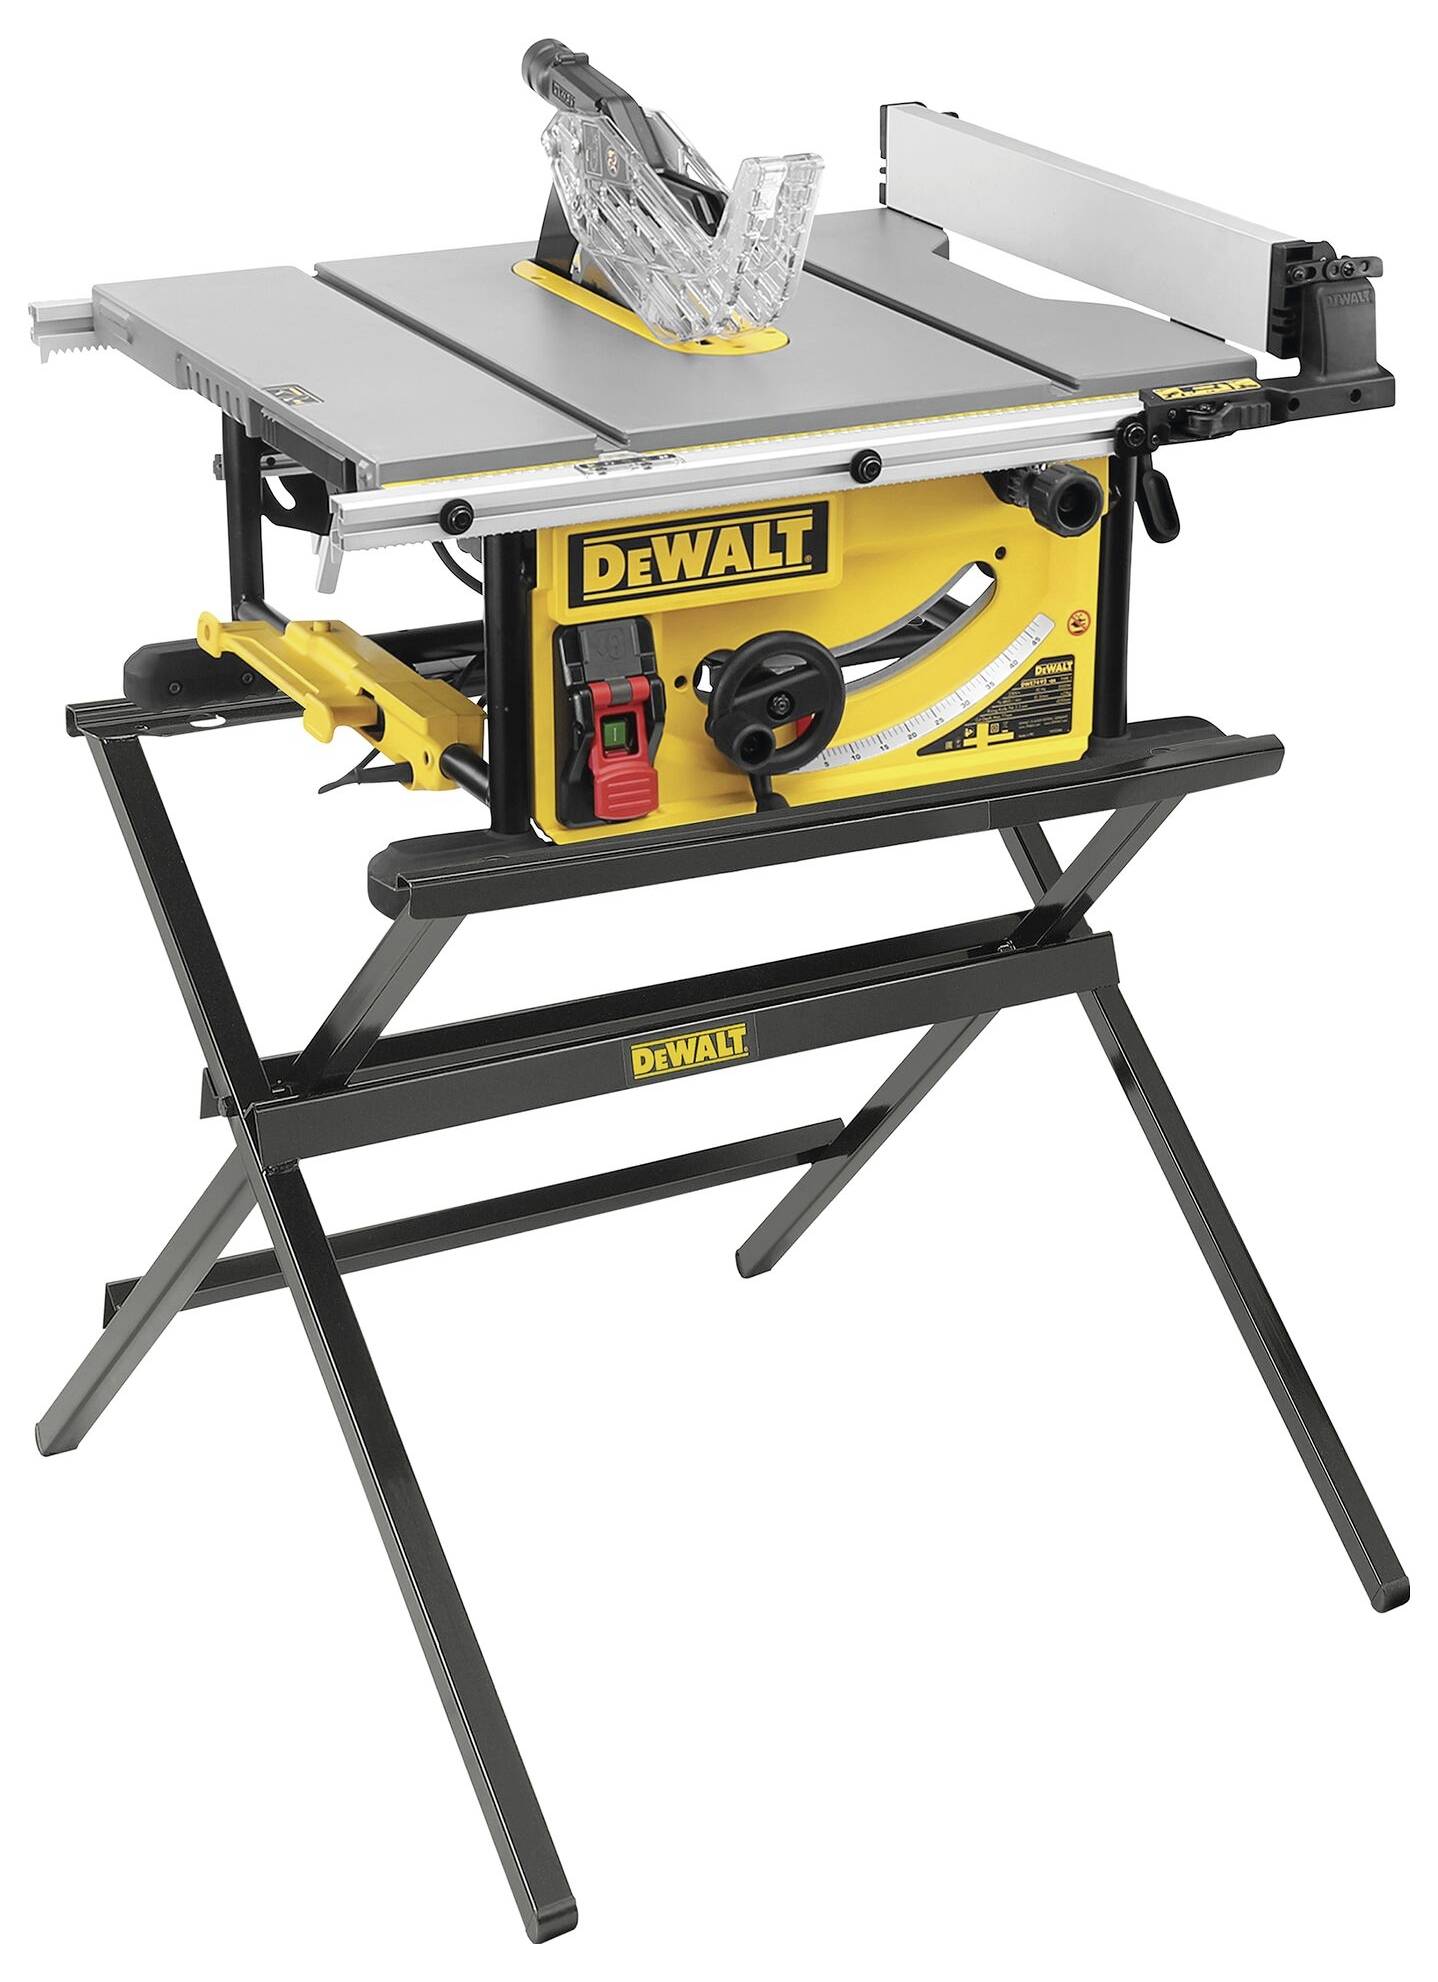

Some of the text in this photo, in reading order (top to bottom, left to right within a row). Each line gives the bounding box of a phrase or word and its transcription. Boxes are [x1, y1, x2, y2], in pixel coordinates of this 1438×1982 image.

[583, 516, 813, 594] DEWALT
[1031, 636, 1041, 646] 45
[1009, 659, 1019, 669] 40
[1034, 660, 1073, 676] DEWALT
[985, 681, 995, 690] 35
[961, 699, 971, 709] 30
[935, 718, 945, 726] 25
[907, 731, 917, 740] 20
[880, 744, 890, 752] 15
[851, 753, 861, 761] 10
[631, 1026, 747, 1076] DEWALT
